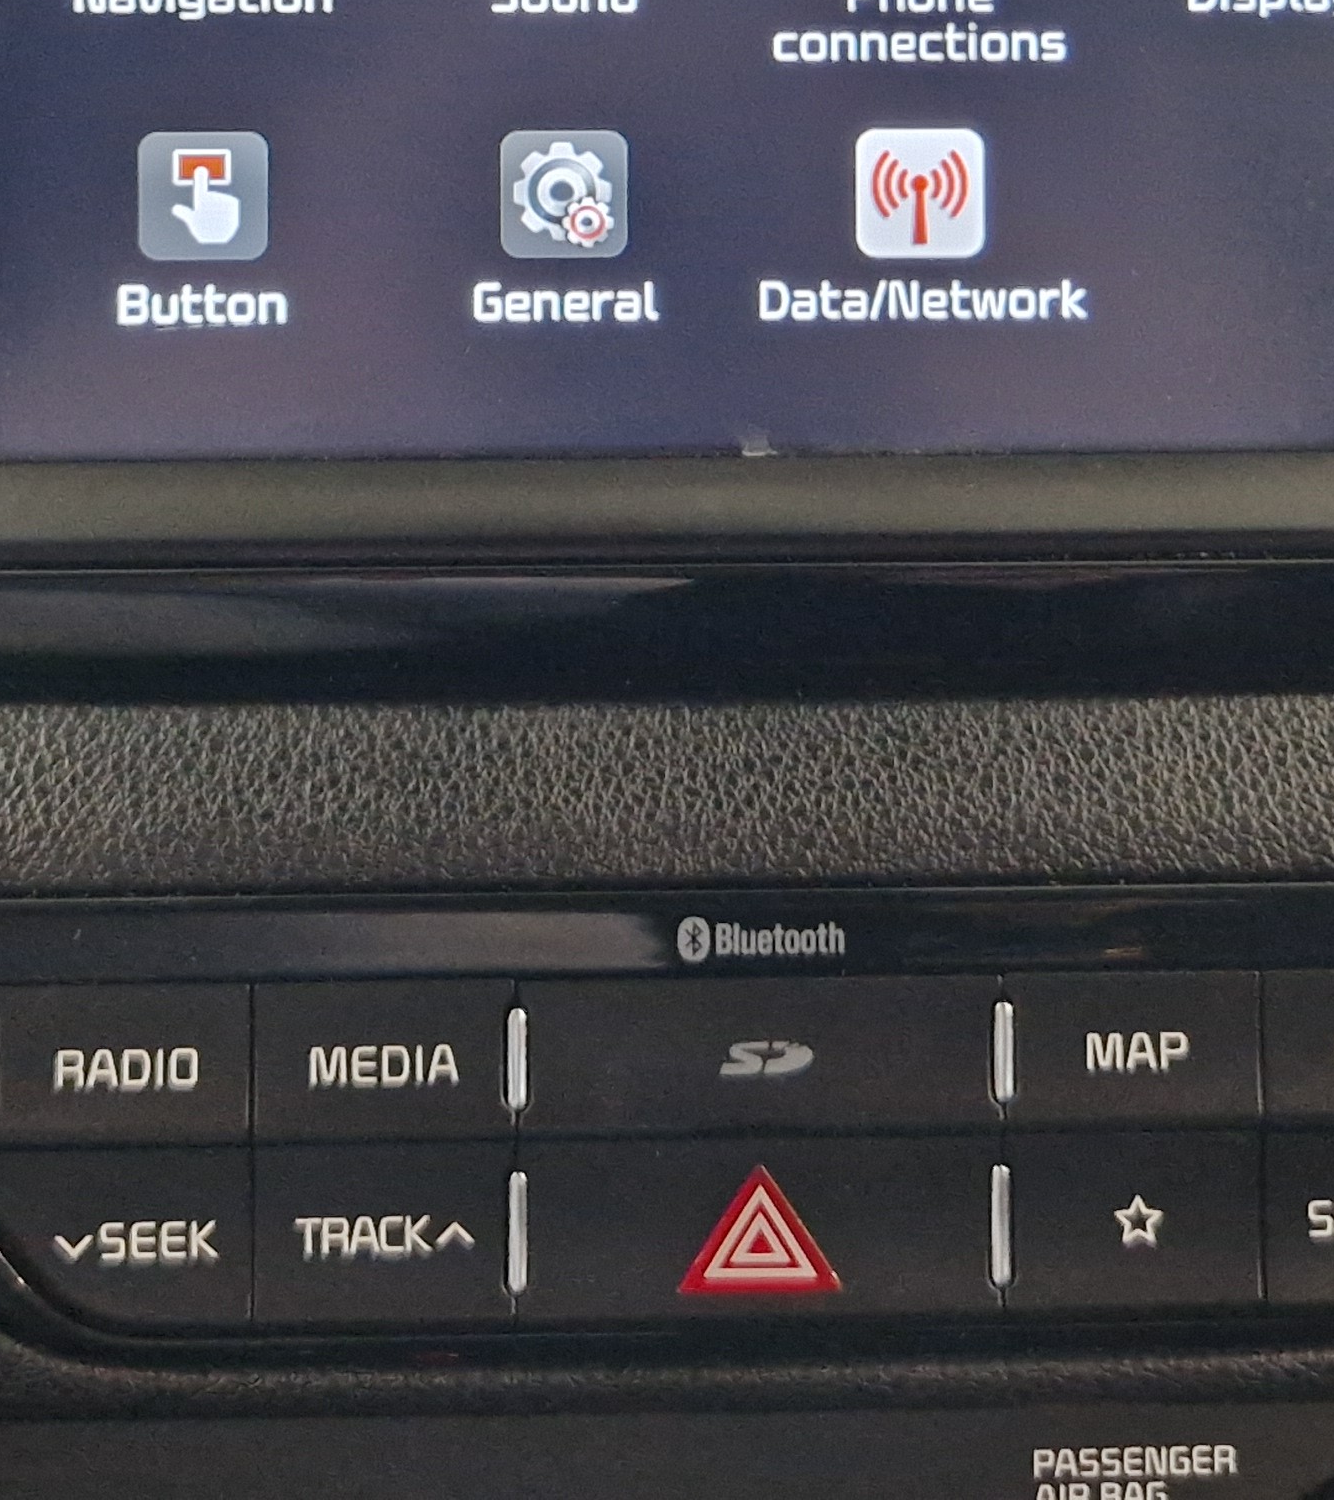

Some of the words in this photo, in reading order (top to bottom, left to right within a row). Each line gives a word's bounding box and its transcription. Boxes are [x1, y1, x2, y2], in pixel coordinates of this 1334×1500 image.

[773, 23, 1066, 62] connections
[117, 284, 287, 326] Button
[473, 281, 659, 323] General
[760, 279, 1088, 321] Data/Network
[716, 921, 845, 955] Bluetooth
[55, 1048, 198, 1089] RADIO
[310, 1044, 458, 1086] MEDIA
[1087, 1032, 1188, 1071] MAP
[99, 1220, 218, 1262] SEEK
[295, 1215, 431, 1256] TRACK
[1034, 1445, 1237, 1477] PASSENGER
